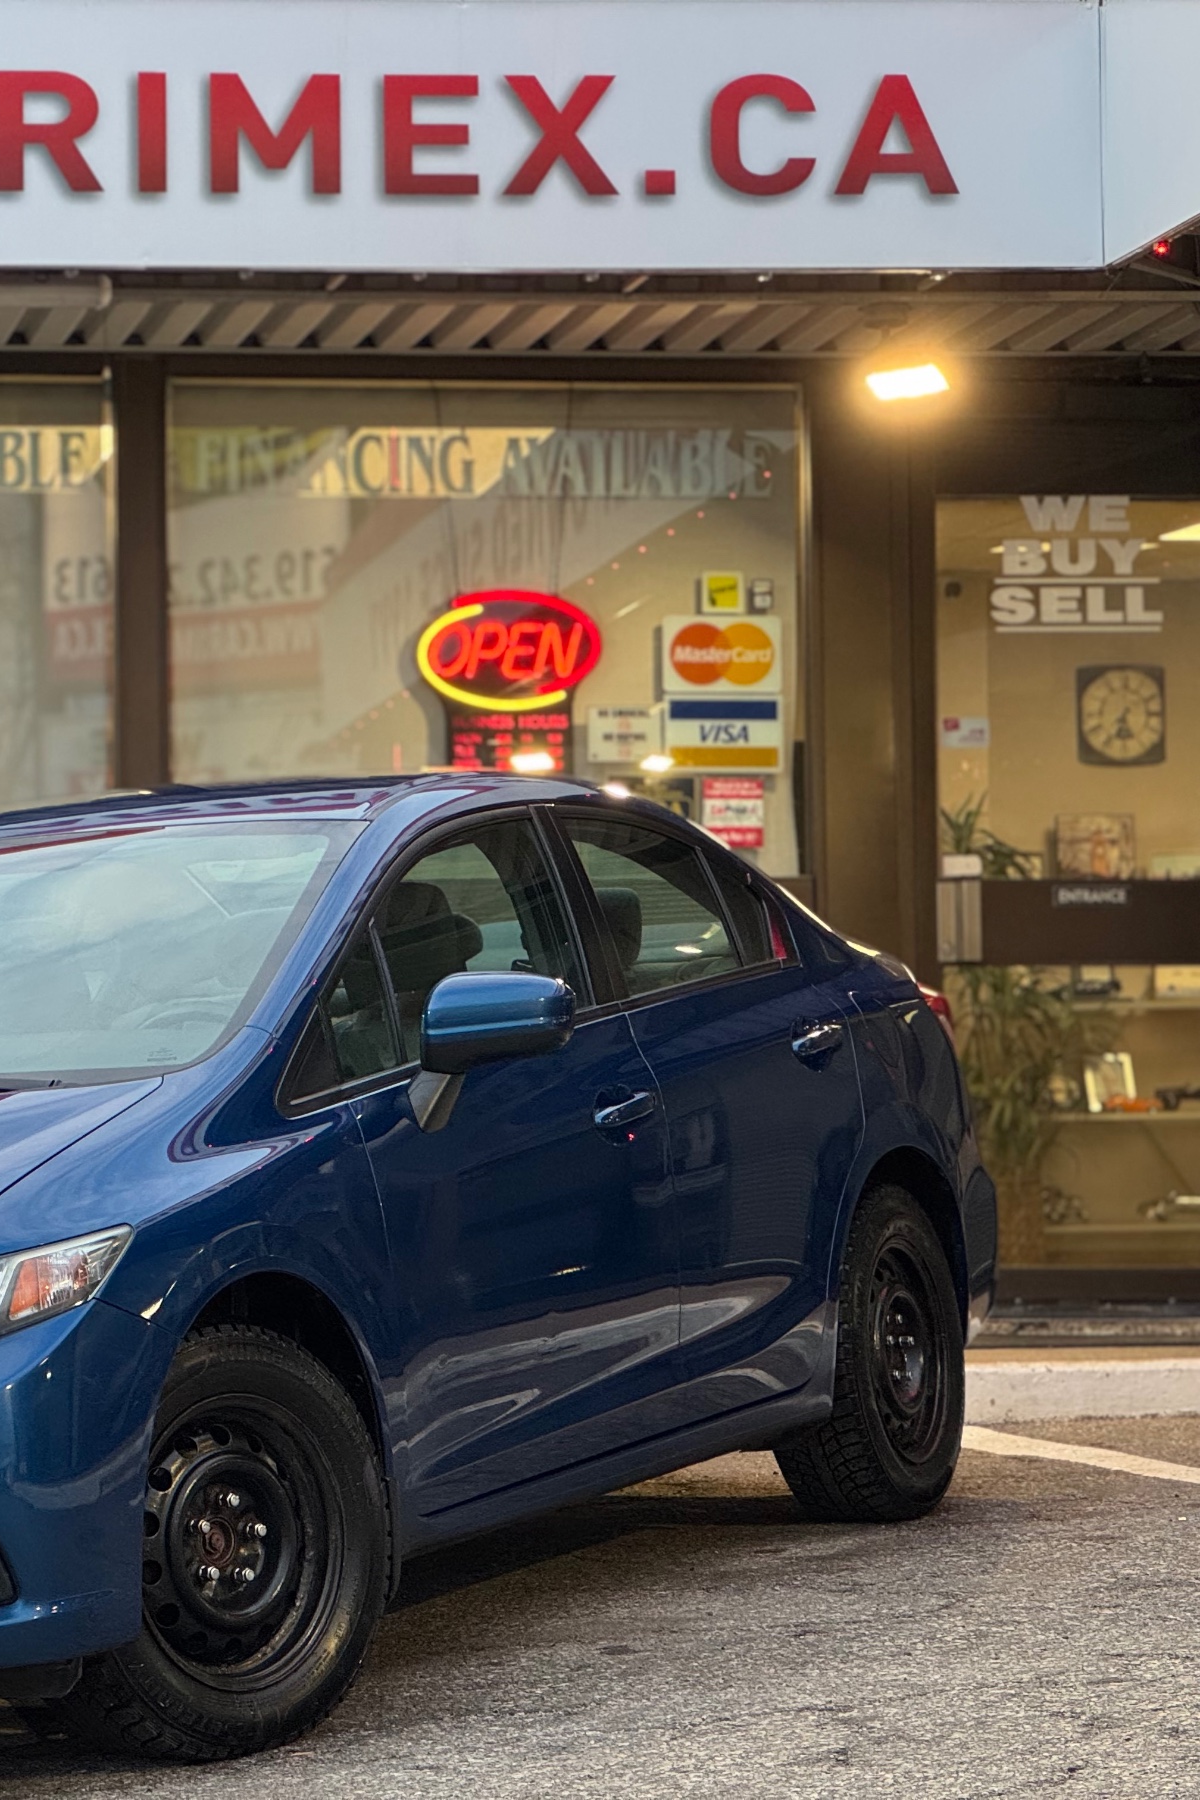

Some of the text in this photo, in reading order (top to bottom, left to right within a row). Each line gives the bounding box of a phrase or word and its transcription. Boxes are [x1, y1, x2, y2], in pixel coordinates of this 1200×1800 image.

[199, 432, 774, 498] FINNCING AVAILABLE
[1019, 496, 1131, 532] WE
[1002, 539, 1145, 576] BUY
[990, 587, 1163, 624] SELL
[429, 621, 583, 679] OPEN
[673, 643, 774, 665] MasterCard
[700, 724, 750, 744] VISA
